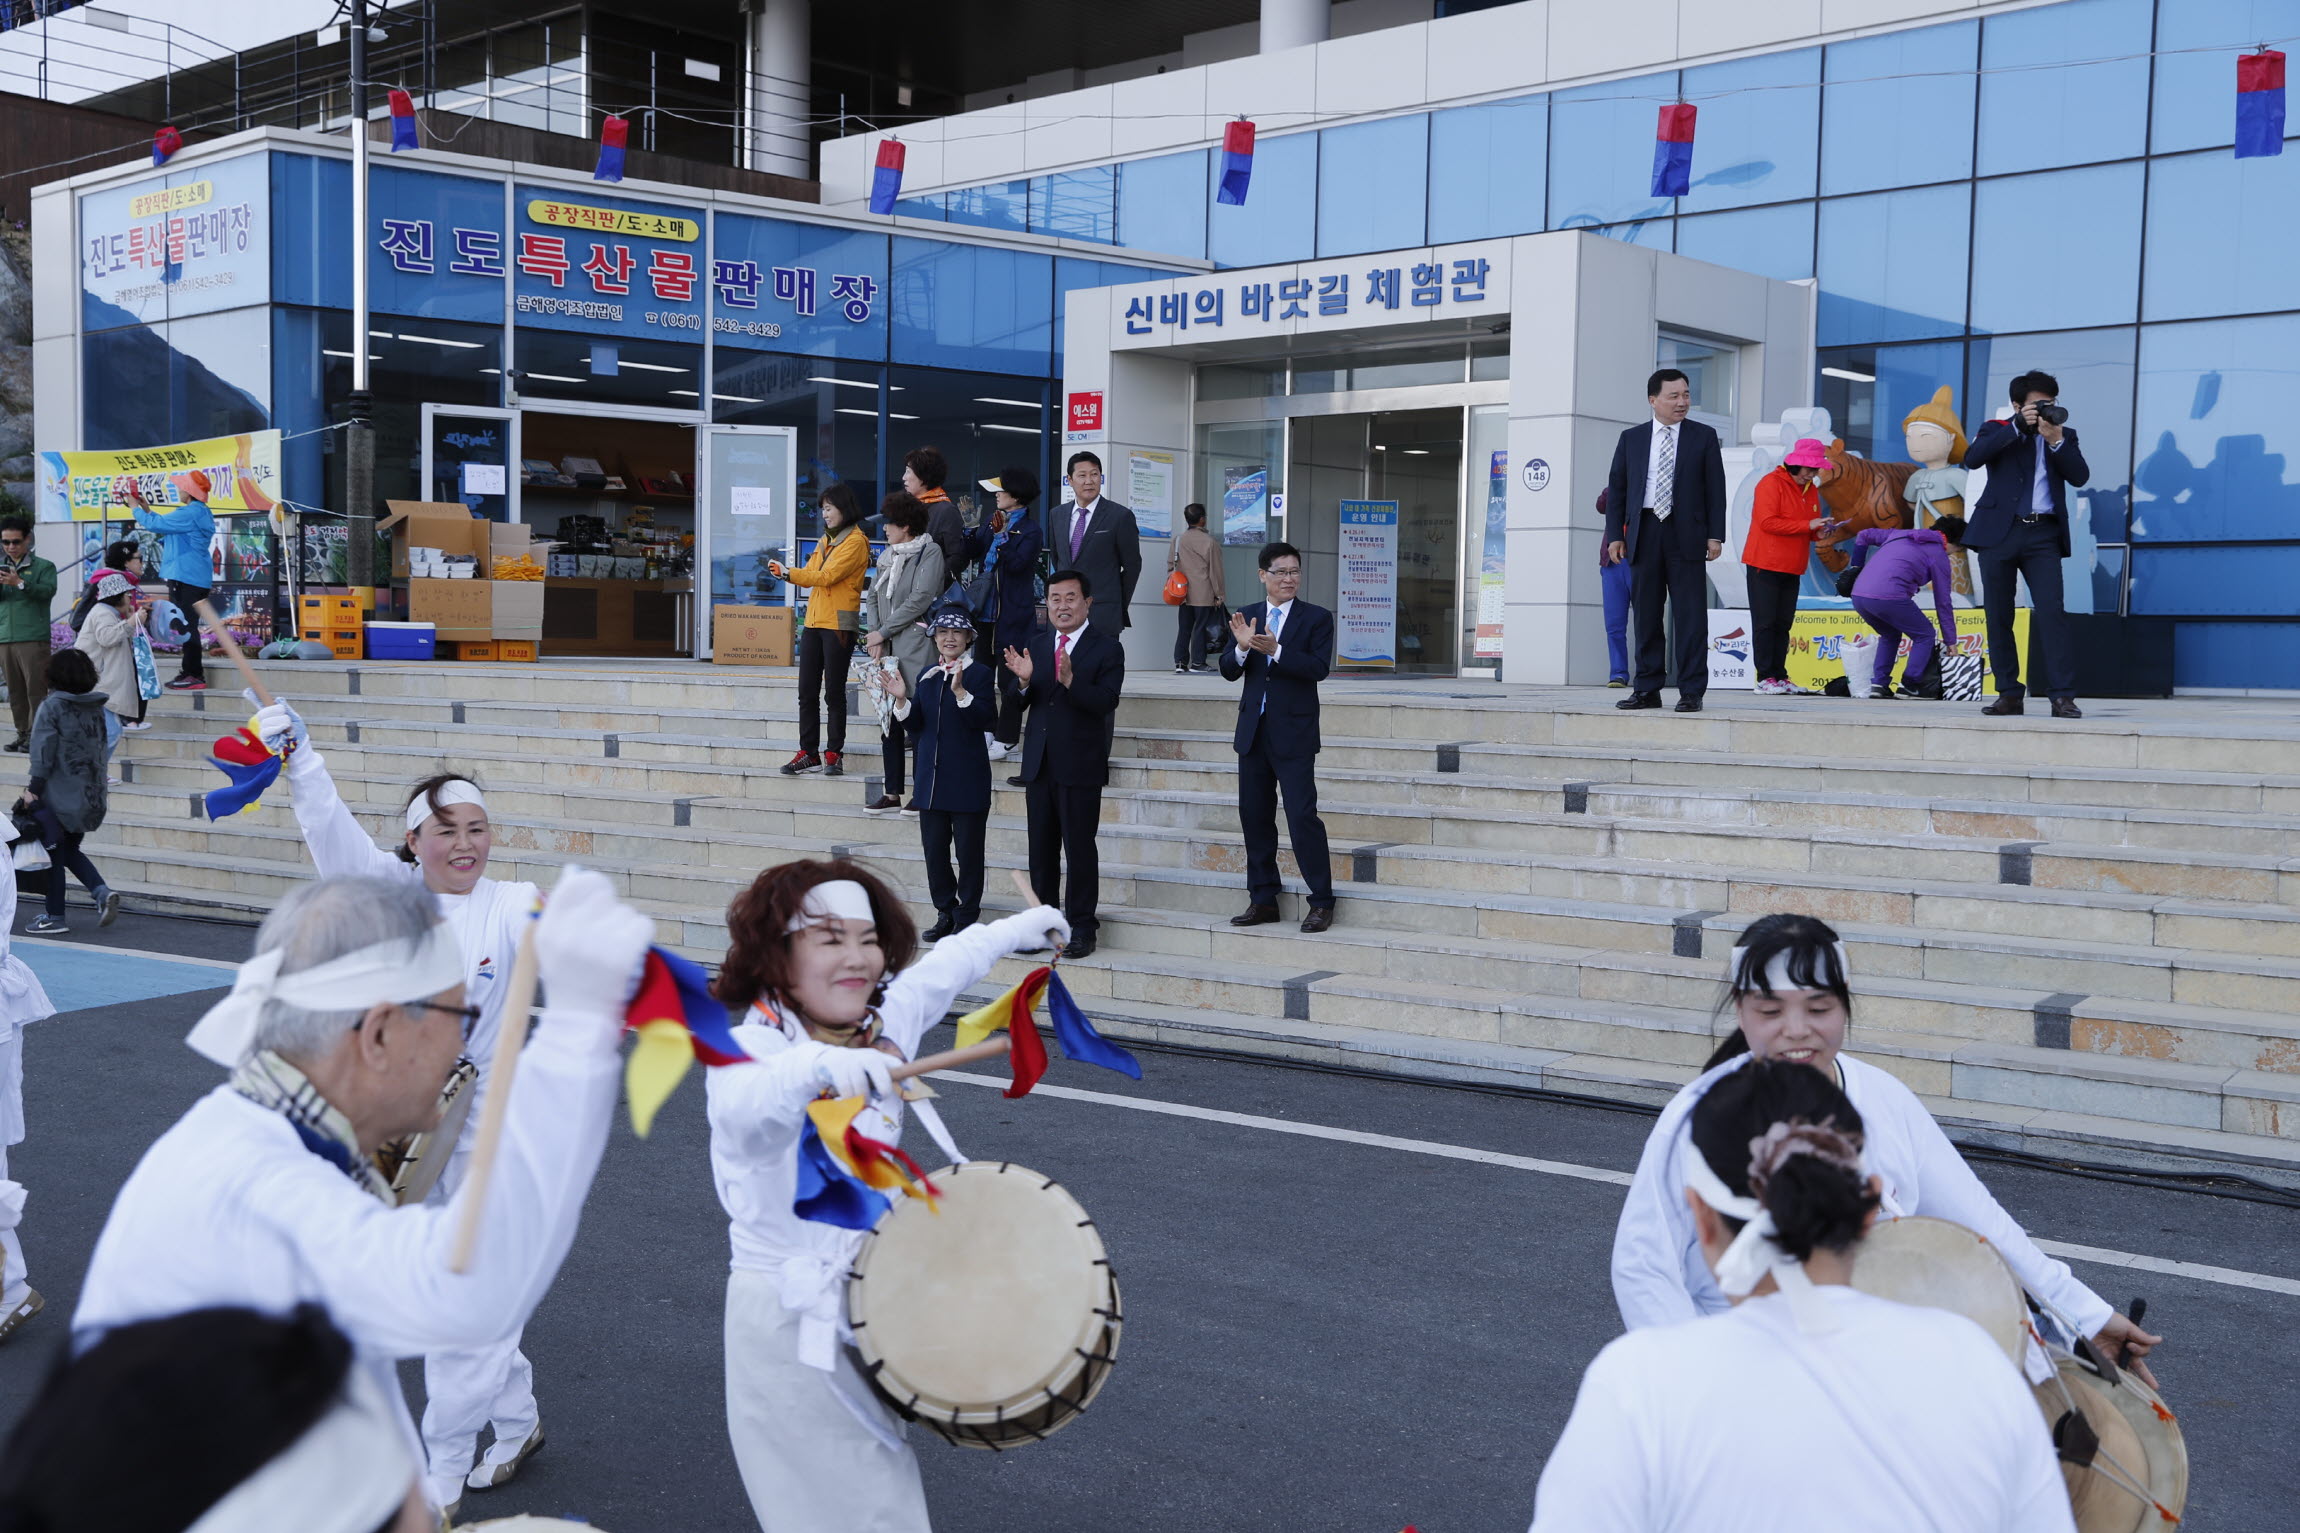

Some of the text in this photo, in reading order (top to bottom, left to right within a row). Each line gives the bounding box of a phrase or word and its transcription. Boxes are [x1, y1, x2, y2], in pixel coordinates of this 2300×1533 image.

[544, 204, 685, 238] 공장직판/도·소매
[91, 203, 251, 279] 진도특산물판매장
[1125, 258, 1491, 335] 신비의 바닷길 체험관
[517, 295, 623, 321] 금해영어조합법인
[713, 318, 782, 338] 542-3429
[1073, 403, 1097, 418] 에스원
[114, 449, 197, 471] 진도 특산품 판매소
[252, 464, 275, 484] 진도
[1528, 472, 1545, 481] 148
[1352, 513, 1386, 523] 운영 안내
[1794, 615, 1827, 624] elcome
[1830, 615, 1838, 624] to
[1955, 615, 1987, 625] Festiv
[1713, 668, 1745, 678] 농수산물
